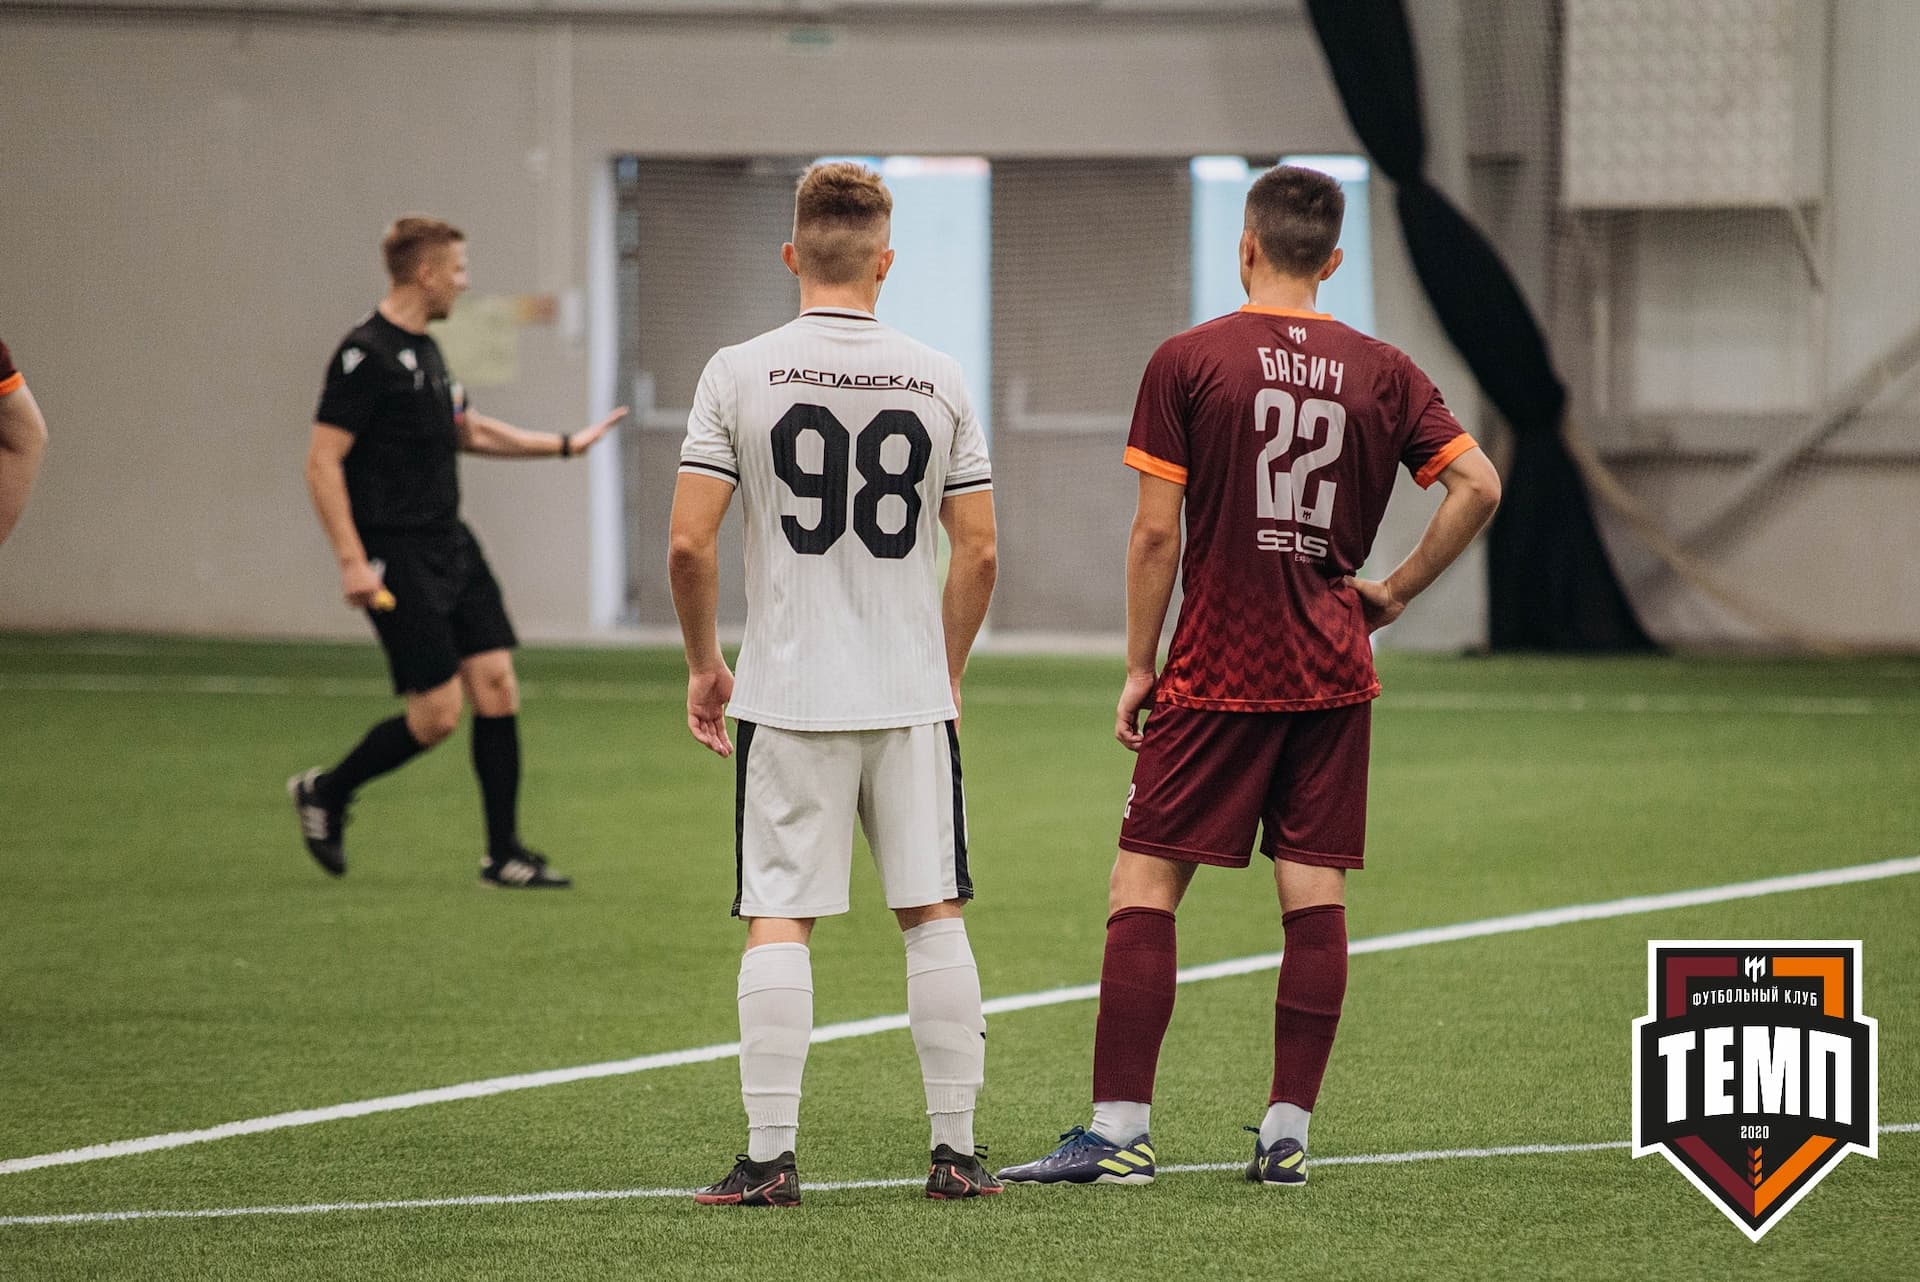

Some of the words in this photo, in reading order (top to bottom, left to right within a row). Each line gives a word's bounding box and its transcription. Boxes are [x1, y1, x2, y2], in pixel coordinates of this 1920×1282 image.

[769, 368, 935, 395] РАСПАДСКАЯ
[1257, 346, 1344, 395] БАБИЧ
[770, 403, 932, 559] 98
[1254, 388, 1346, 529] 22
